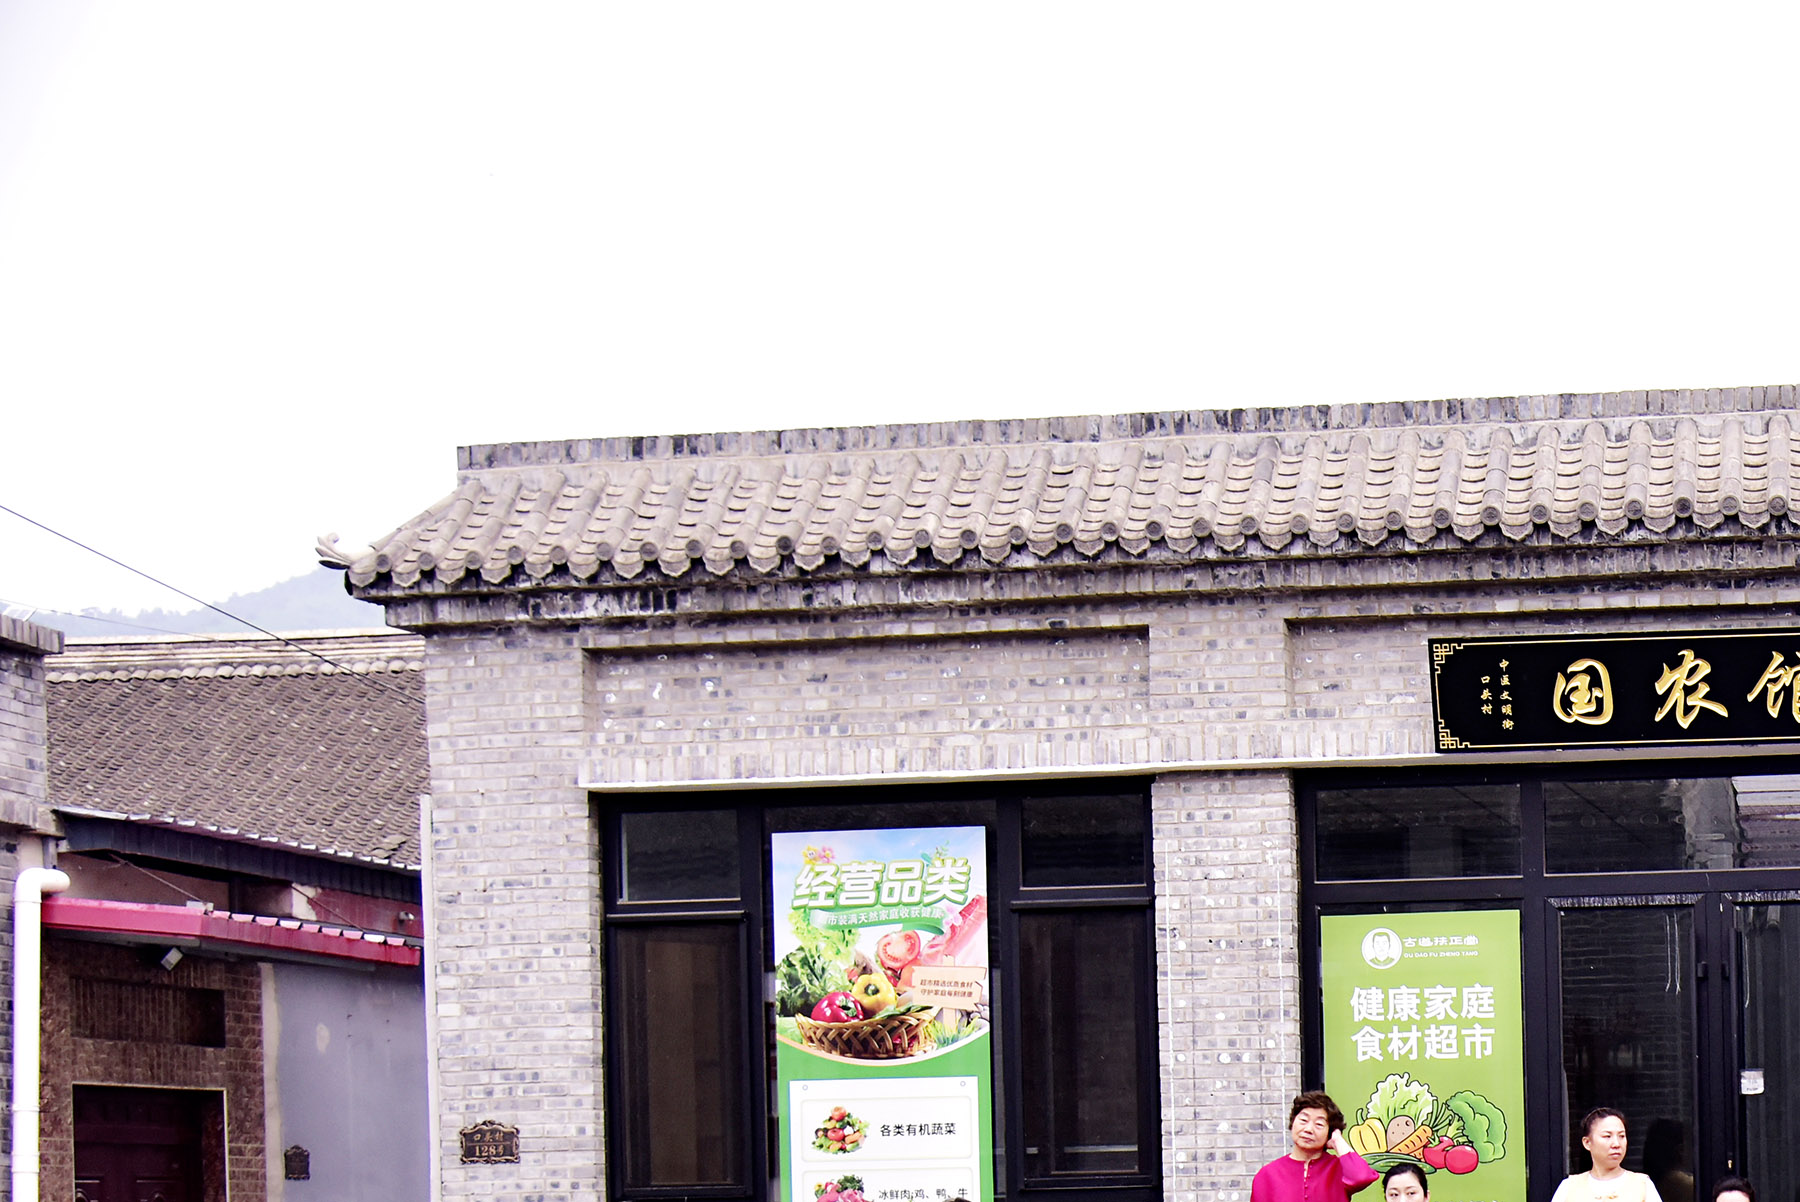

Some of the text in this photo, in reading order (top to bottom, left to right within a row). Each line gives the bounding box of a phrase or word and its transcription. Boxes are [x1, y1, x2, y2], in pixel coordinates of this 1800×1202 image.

[791, 857, 971, 908] 经营品类
[1350, 982, 1496, 1022] 健康家庭
[1350, 1022, 1496, 1062] 食材超市
[880, 1122, 957, 1137] 各类有机蔬菜
